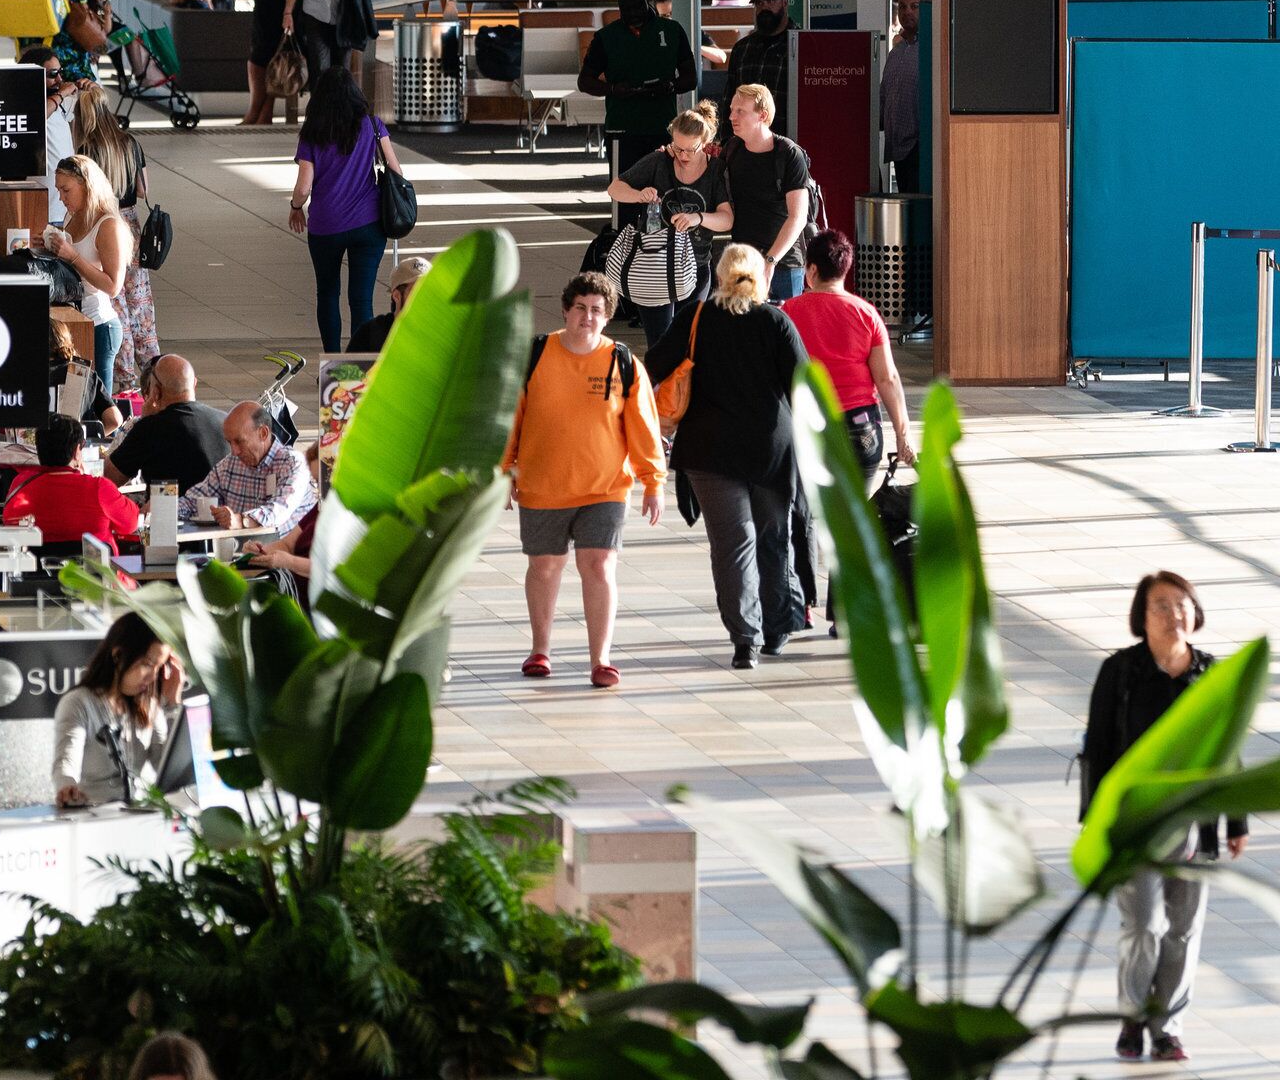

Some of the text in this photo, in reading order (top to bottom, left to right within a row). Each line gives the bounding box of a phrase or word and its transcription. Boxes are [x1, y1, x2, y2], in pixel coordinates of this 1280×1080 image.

[658, 31, 667, 47] 1
[804, 64, 866, 76] international
[804, 75, 848, 86] transfers
